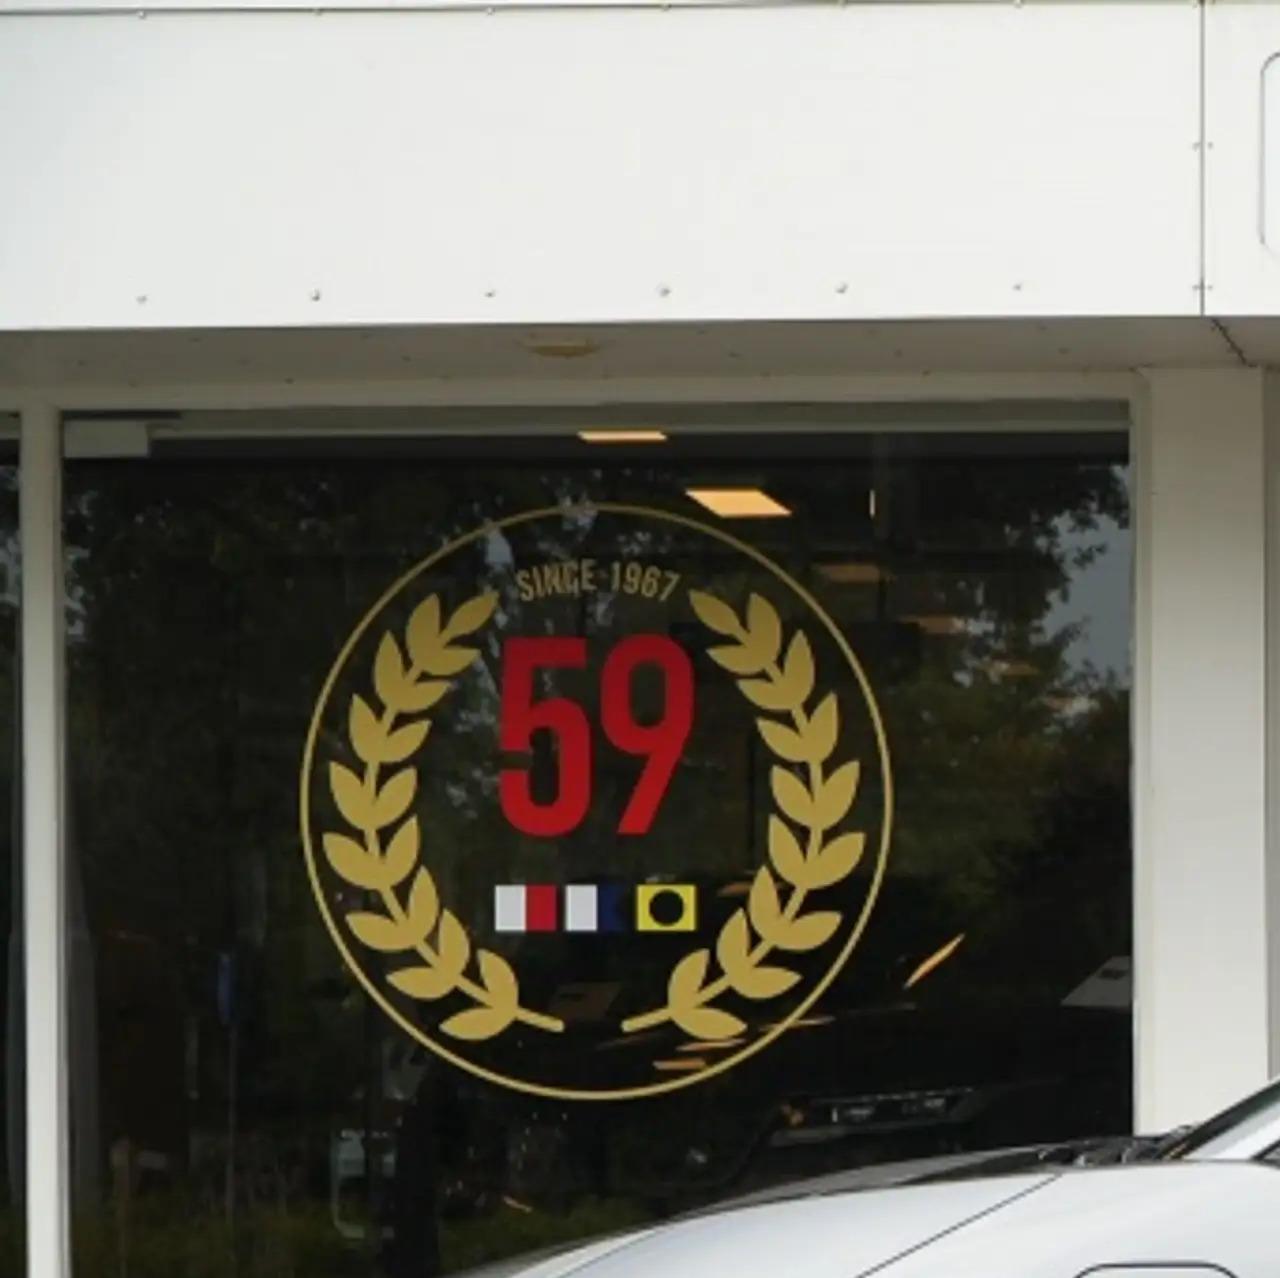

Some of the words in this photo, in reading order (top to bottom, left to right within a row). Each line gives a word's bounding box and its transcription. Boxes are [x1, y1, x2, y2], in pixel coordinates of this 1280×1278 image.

[515, 558, 597, 602] SINCE
[611, 561, 681, 602] 1967
[499, 634, 695, 837] 59
